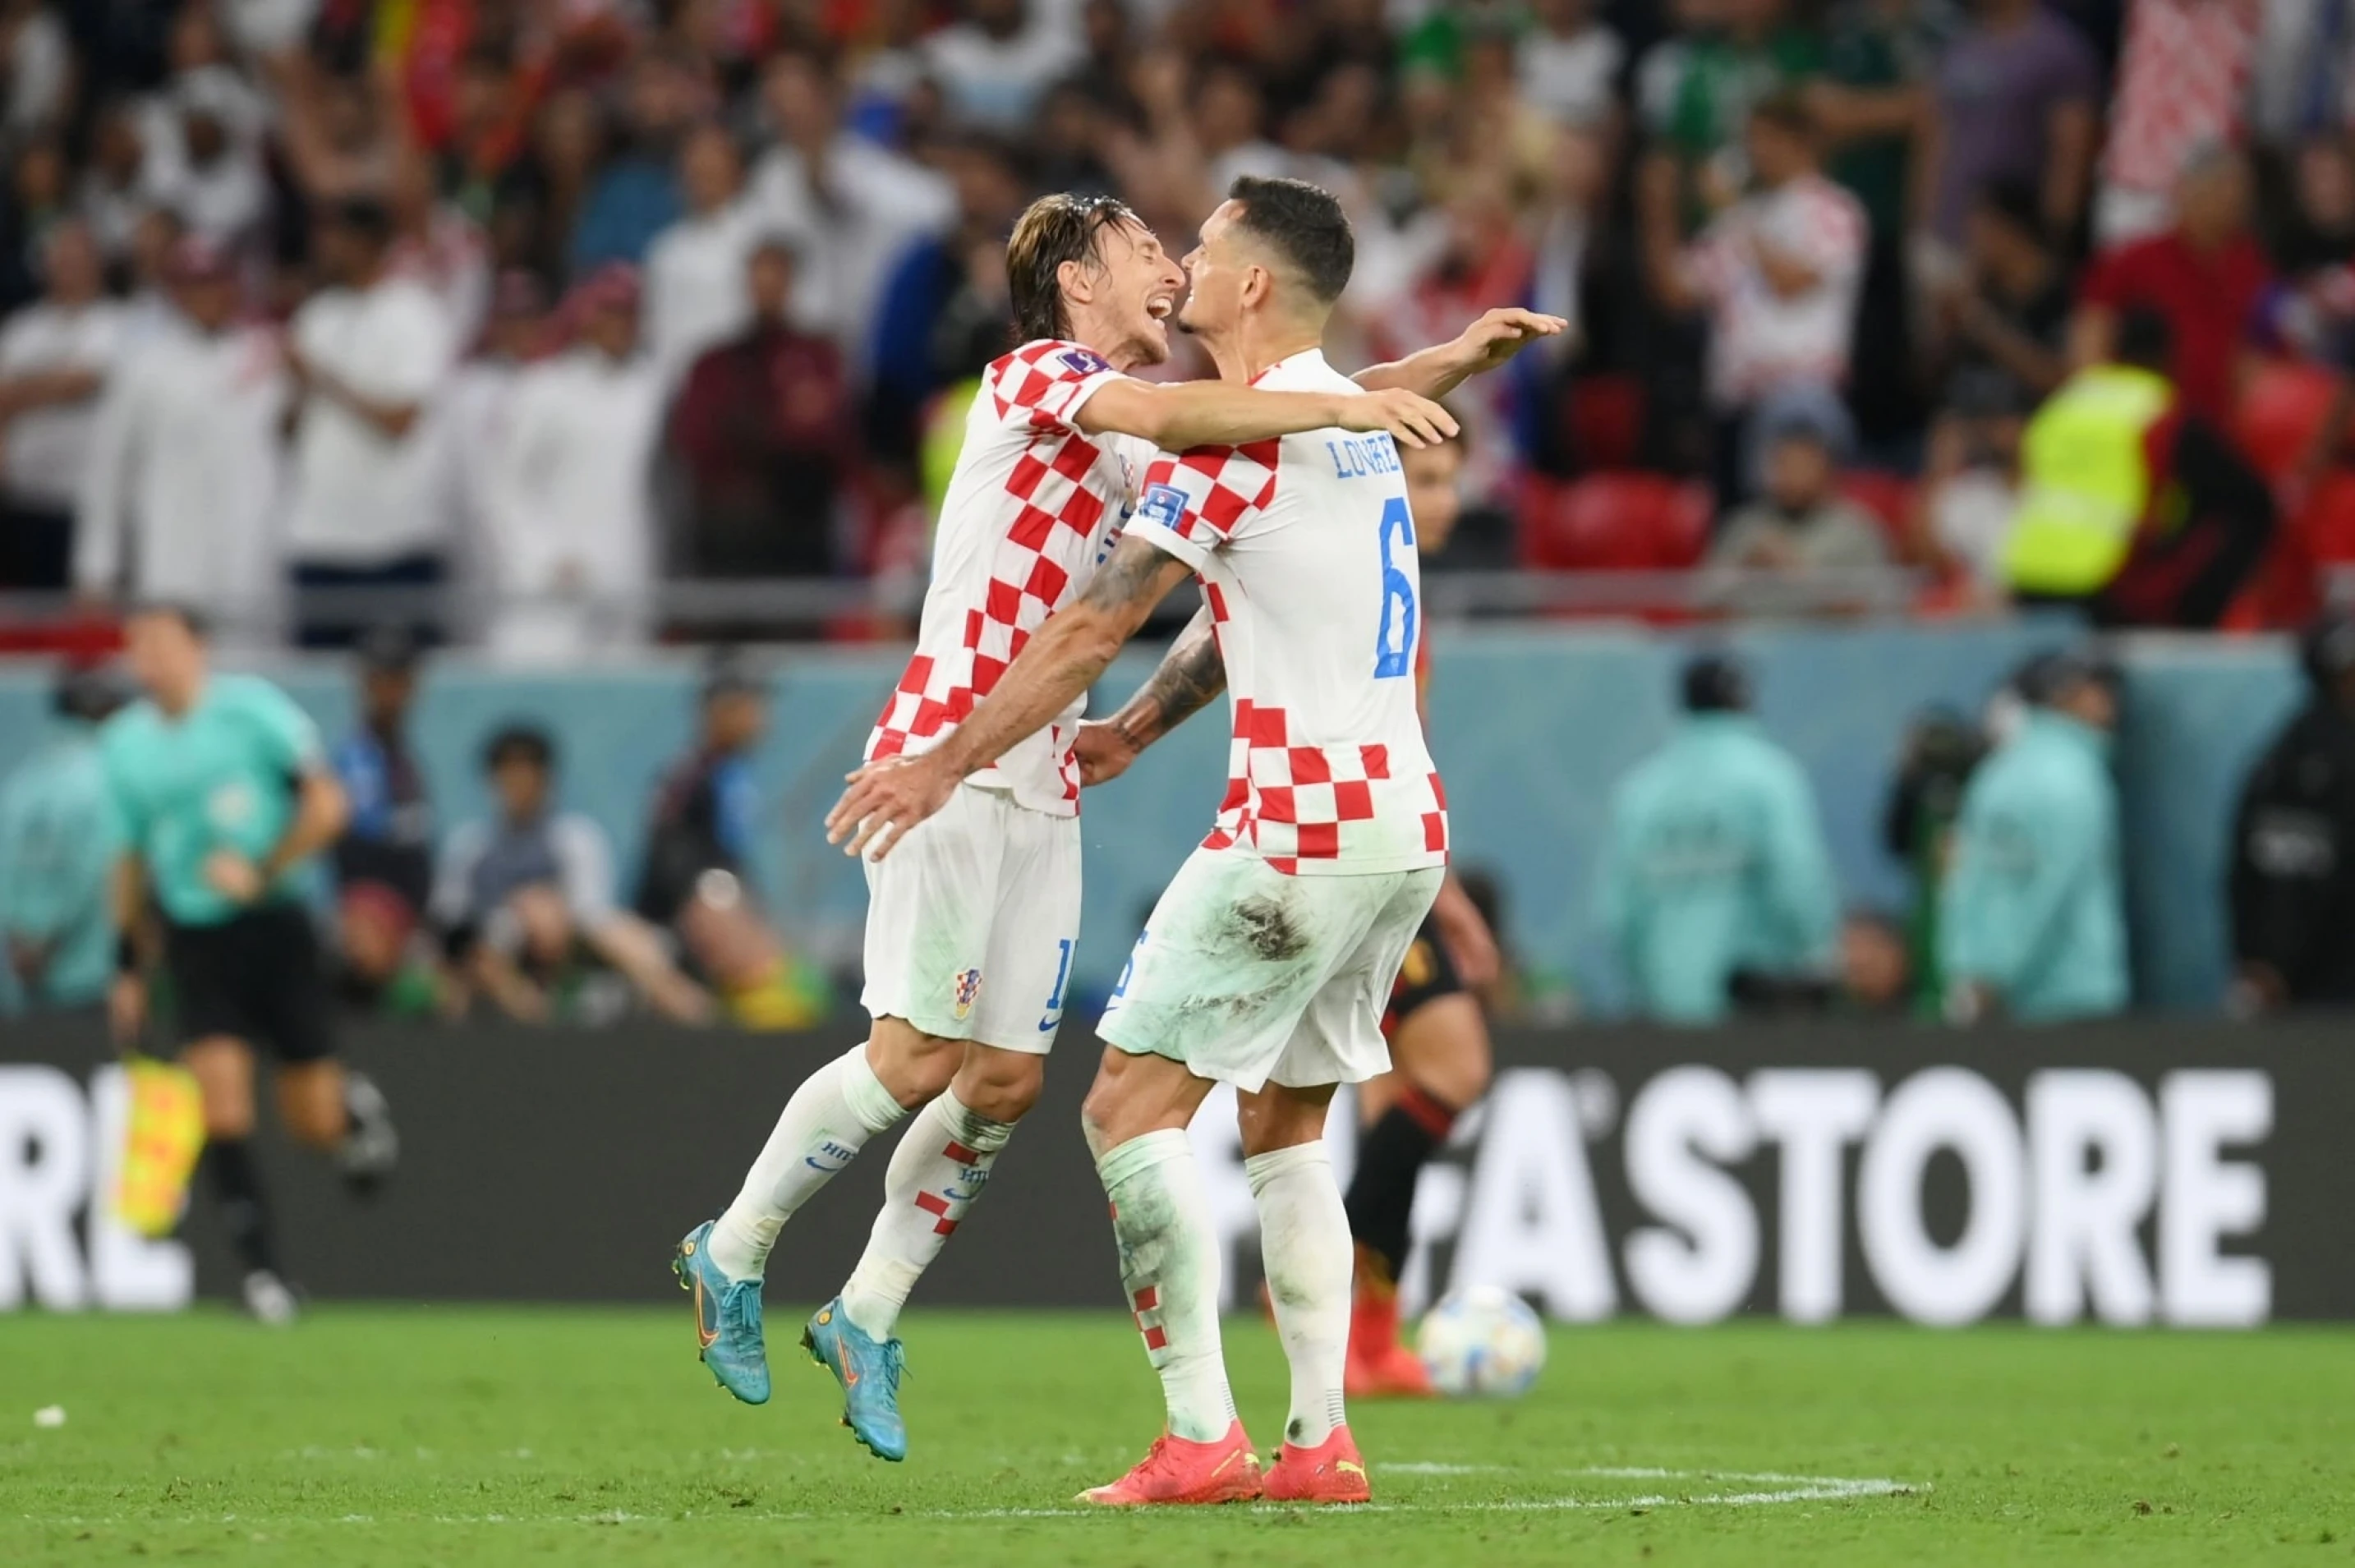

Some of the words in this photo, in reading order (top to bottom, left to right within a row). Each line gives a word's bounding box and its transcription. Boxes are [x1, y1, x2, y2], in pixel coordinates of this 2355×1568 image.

[1373, 496, 1415, 679] 6
[1046, 938, 1078, 1009] 1
[1183, 1066, 1618, 1322] FA
[1622, 1064, 2275, 1327] STORE
